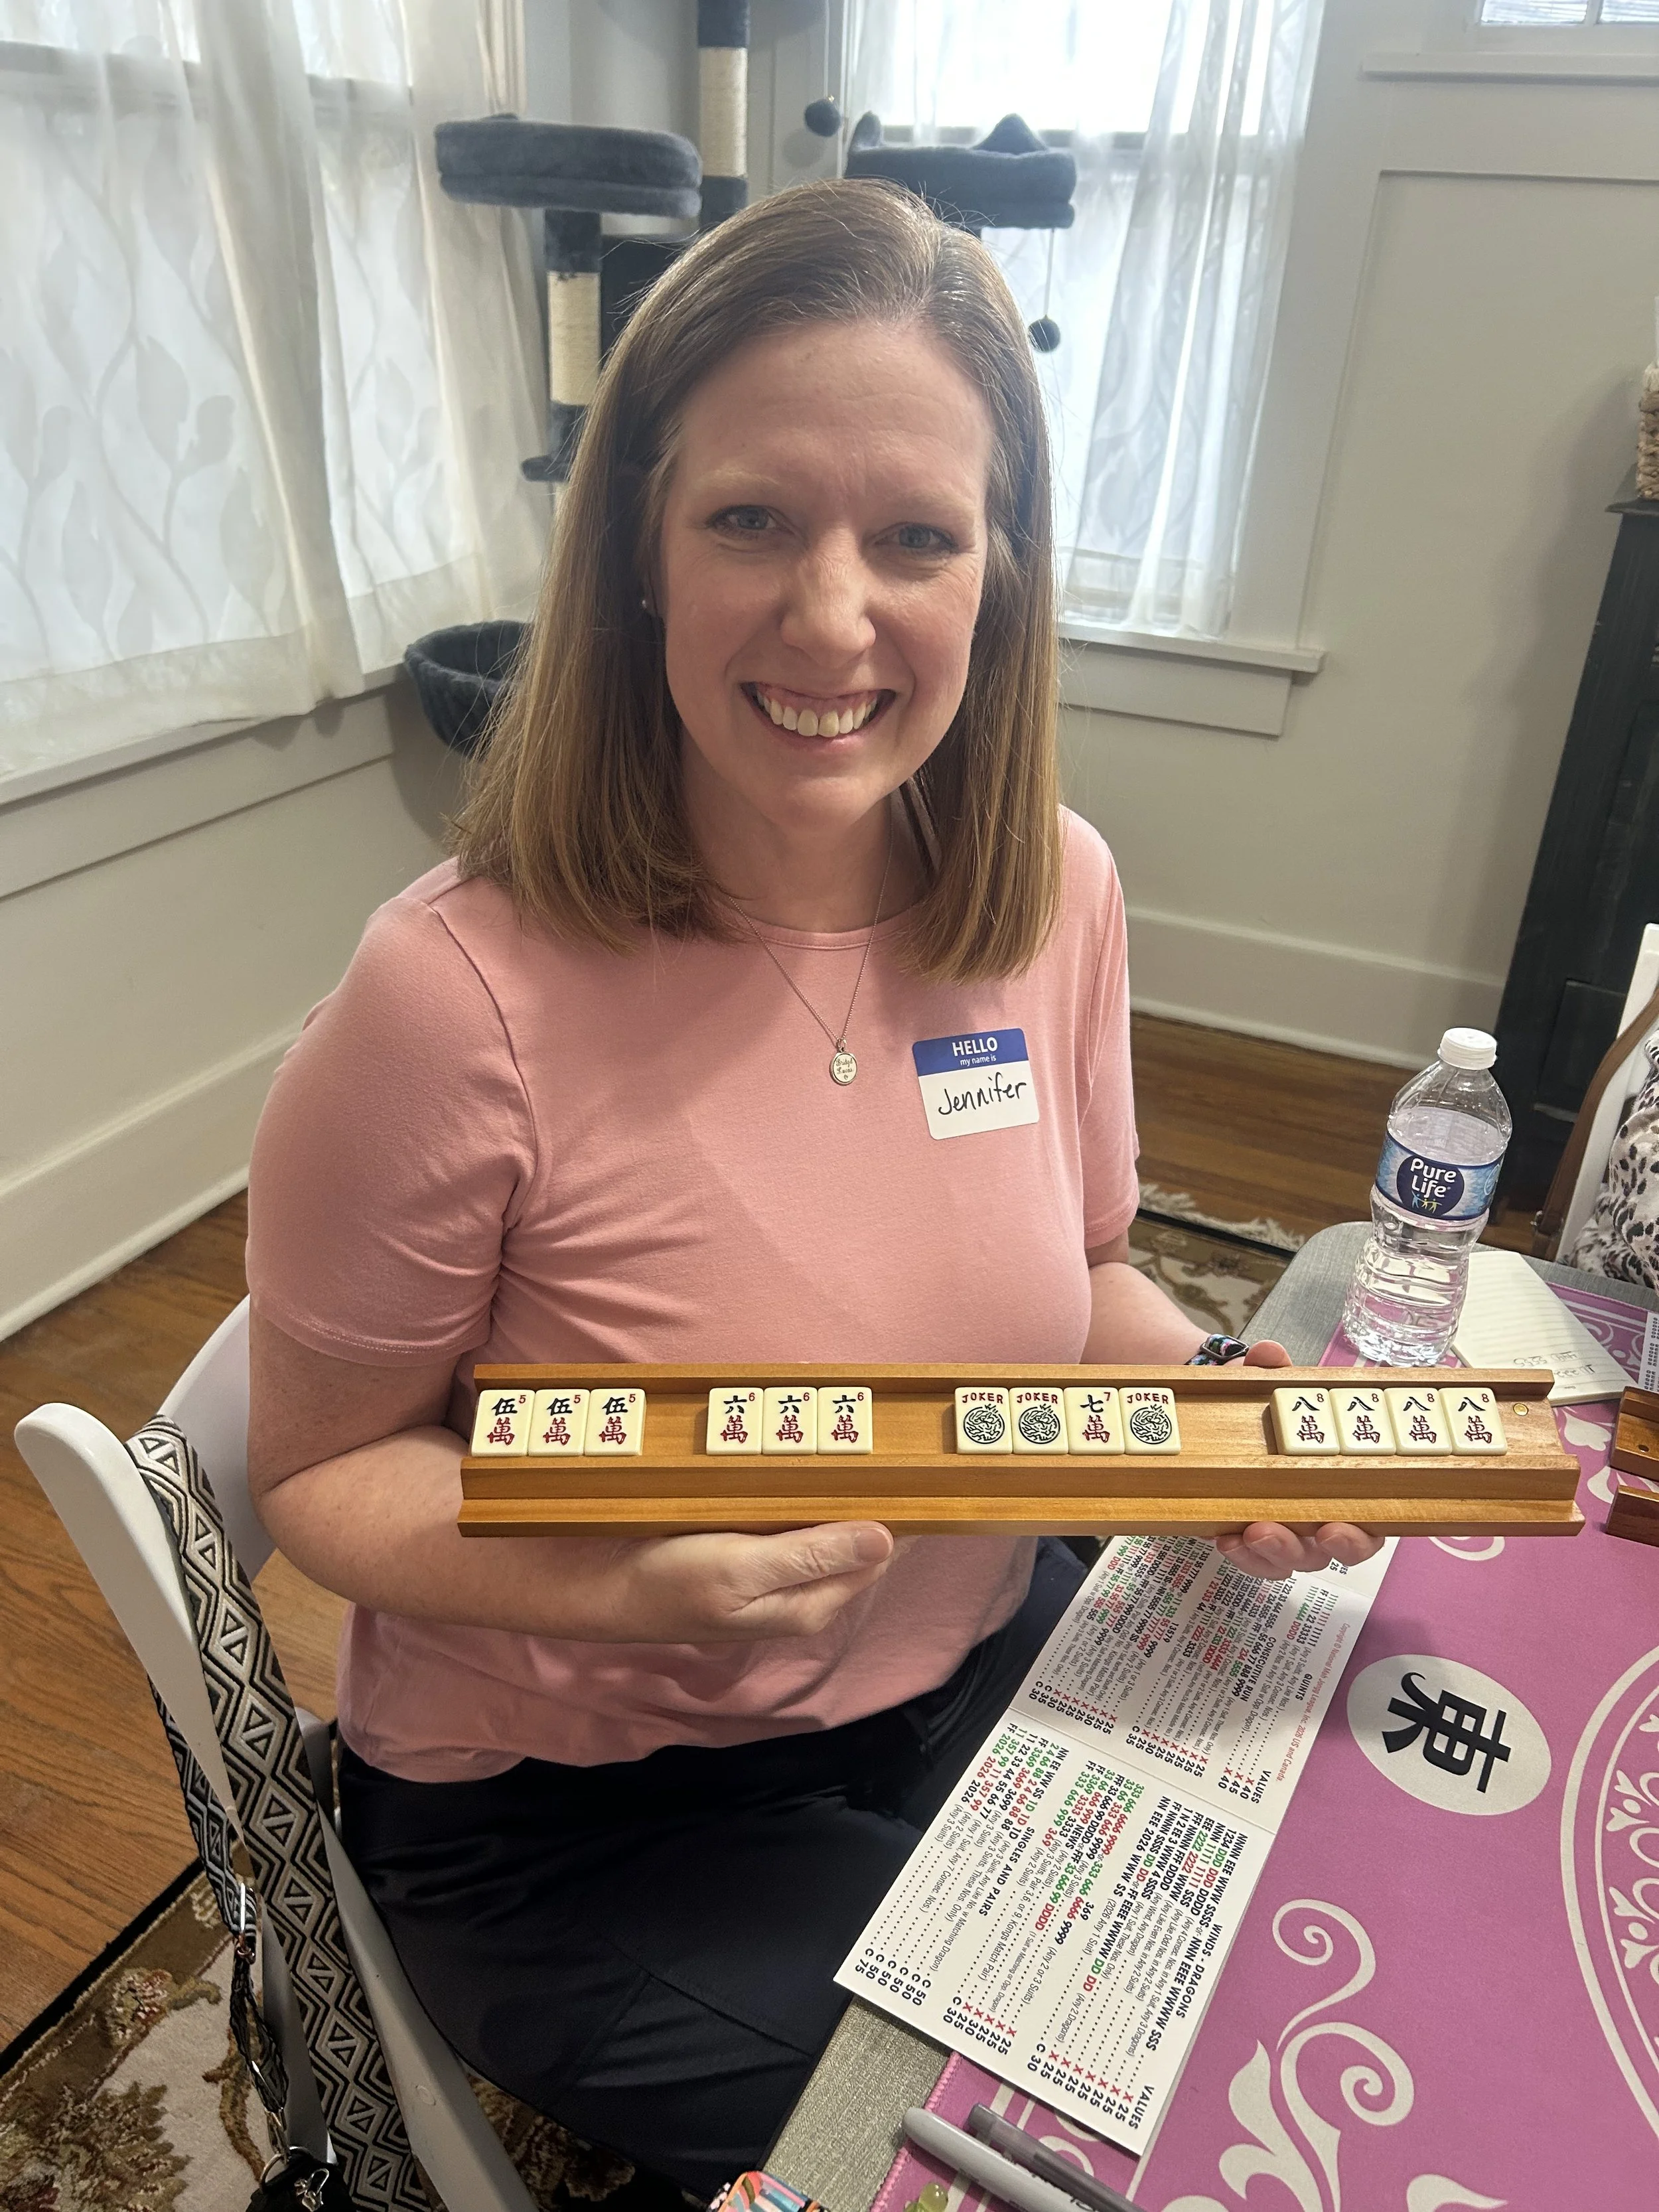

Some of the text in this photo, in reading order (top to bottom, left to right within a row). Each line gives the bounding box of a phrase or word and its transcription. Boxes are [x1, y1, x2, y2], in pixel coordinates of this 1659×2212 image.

[952, 1037, 998, 1057] HELLO
[971, 1056, 989, 1065] name
[938, 1071, 1027, 1116] Jennifer
[1410, 1157, 1457, 1183] Pure
[1411, 1175, 1447, 1199] Life
[518, 1395, 526, 1404] 5
[573, 1394, 581, 1404] 5
[628, 1394, 636, 1402] 5
[749, 1392, 755, 1401] 6
[803, 1392, 810, 1401] 6
[857, 1392, 864, 1401] 6
[962, 1392, 1003, 1404] JOKER
[1016, 1392, 1058, 1404] JOKER
[1104, 1392, 1111, 1401] 7
[1127, 1392, 1169, 1404] JOKER
[1317, 1393, 1325, 1402] 8
[1372, 1393, 1380, 1402] 8
[1427, 1393, 1435, 1402] 8
[1482, 1393, 1489, 1402] 8
[1329, 1562, 1340, 1571] 25
[1162, 1622, 1179, 1643] 13579
[1239, 1637, 1276, 1702] CONSECUTIVE RUN
[1299, 1714, 1310, 1724] Inc.
[1007, 1723, 1017, 1733] FF
[1294, 1724, 1305, 1738] 2026
[1382, 1672, 1512, 1794] 東
[991, 1733, 1010, 1755] 2026
[1026, 1733, 1037, 1743] 11
[1038, 1737, 1048, 1747] FF
[1250, 1673, 1312, 1803] QUINTS VALUES
[1291, 1737, 1300, 1747] US
[1017, 1743, 1030, 1755] 22
[1285, 1747, 1295, 1759] and
[1011, 1755, 1023, 1767] 33
[1025, 1747, 1043, 1767] 3369
[977, 1755, 995, 1778] 2026
[1085, 1760, 1096, 1771] FF
[1003, 1767, 1014, 1780] 44
[1012, 1767, 1030, 1789] 3669
[1074, 1771, 1090, 1788] 333
[1103, 1769, 1115, 1780] 33
[961, 1779, 980, 1803] 2026
[995, 1780, 1007, 1793] 55
[1098, 1780, 1108, 1791] 66
[1123, 1779, 1135, 1790] 33
[987, 1793, 999, 1805] 66
[999, 1789, 1017, 1810] 3699
[1064, 1789, 1078, 1806] 666
[1088, 1791, 1102, 1807] 666
[1116, 1790, 1127, 1801] 66
[1157, 1796, 1171, 1810] NN
[949, 1804, 964, 1818] (Any
[979, 1806, 991, 1819] 77
[987, 1810, 1001, 1824] (Any
[1053, 1808, 1068, 1826] 999
[1079, 1808, 1094, 1824] 999
[1108, 1802, 1122, 1818] 333
[1148, 1810, 1163, 1827] EEE
[1191, 1811, 1204, 1826] FFF
[934, 1824, 952, 1842] Suits)
[967, 1819, 981, 1834] (Any
[1098, 1818, 1112, 1836] 666
[974, 1829, 991, 1847] Suits)
[1041, 1827, 1057, 1848] 369
[1064, 1824, 1084, 1849] NEWS
[1135, 1827, 1154, 1851] 2026
[1179, 1824, 1197, 1850] NNNN
[1030, 1846, 1045, 1862] (Any
[1085, 1836, 1103, 1860] 9999
[948, 1852, 961, 1866] Any
[1054, 1850, 1068, 1865] (Any
[1172, 1849, 1185, 1865] FFF
[978, 1826, 1035, 1916] SINGLES AND PAIRS
[1075, 1860, 1089, 1875] (Any
[1121, 1854, 1141, 1882] WWW
[931, 1870, 951, 1893] Consec.
[1015, 1867, 1033, 1886] Suits)
[1041, 1869, 1058, 1887] Suits)
[1159, 1863, 1179, 1890] DDDD
[1062, 1880, 1078, 1897] Suits)
[1113, 1883, 1125, 1897] SS
[918, 1895, 936, 1913] Nos.)
[1149, 1892, 1163, 1906] (Any
[1080, 1901, 1094, 1920] 369
[1102, 1898, 1116, 1919] (2026
[1093, 1917, 1107, 1932] Any
[1137, 1920, 1149, 1933] Any
[1082, 1938, 1097, 1954] Suit)
[1125, 1932, 1144, 1956] Dragon)
[1202, 1923, 1222, 1956] WINDS
[865, 1948, 873, 1956] C
[855, 1958, 869, 1973] 75
[887, 1960, 896, 1968] C
[899, 1966, 908, 1975] C
[877, 1970, 891, 1986] 50
[889, 1977, 903, 1992] 50
[1175, 1964, 1204, 2018] DRAGONS
[952, 1996, 962, 2005] C
[942, 2007, 956, 2023] 30
[973, 2008, 983, 2019] X
[964, 2019, 978, 2035] 30
[995, 2020, 1005, 2031] X
[986, 2031, 1000, 2049] 25
[1036, 2043, 1045, 2052] C
[1027, 2055, 1041, 2071] 30
[1072, 2063, 1083, 2075] X
[1064, 2075, 1078, 2093] 25
[1128, 2085, 1154, 2129] VALUES
